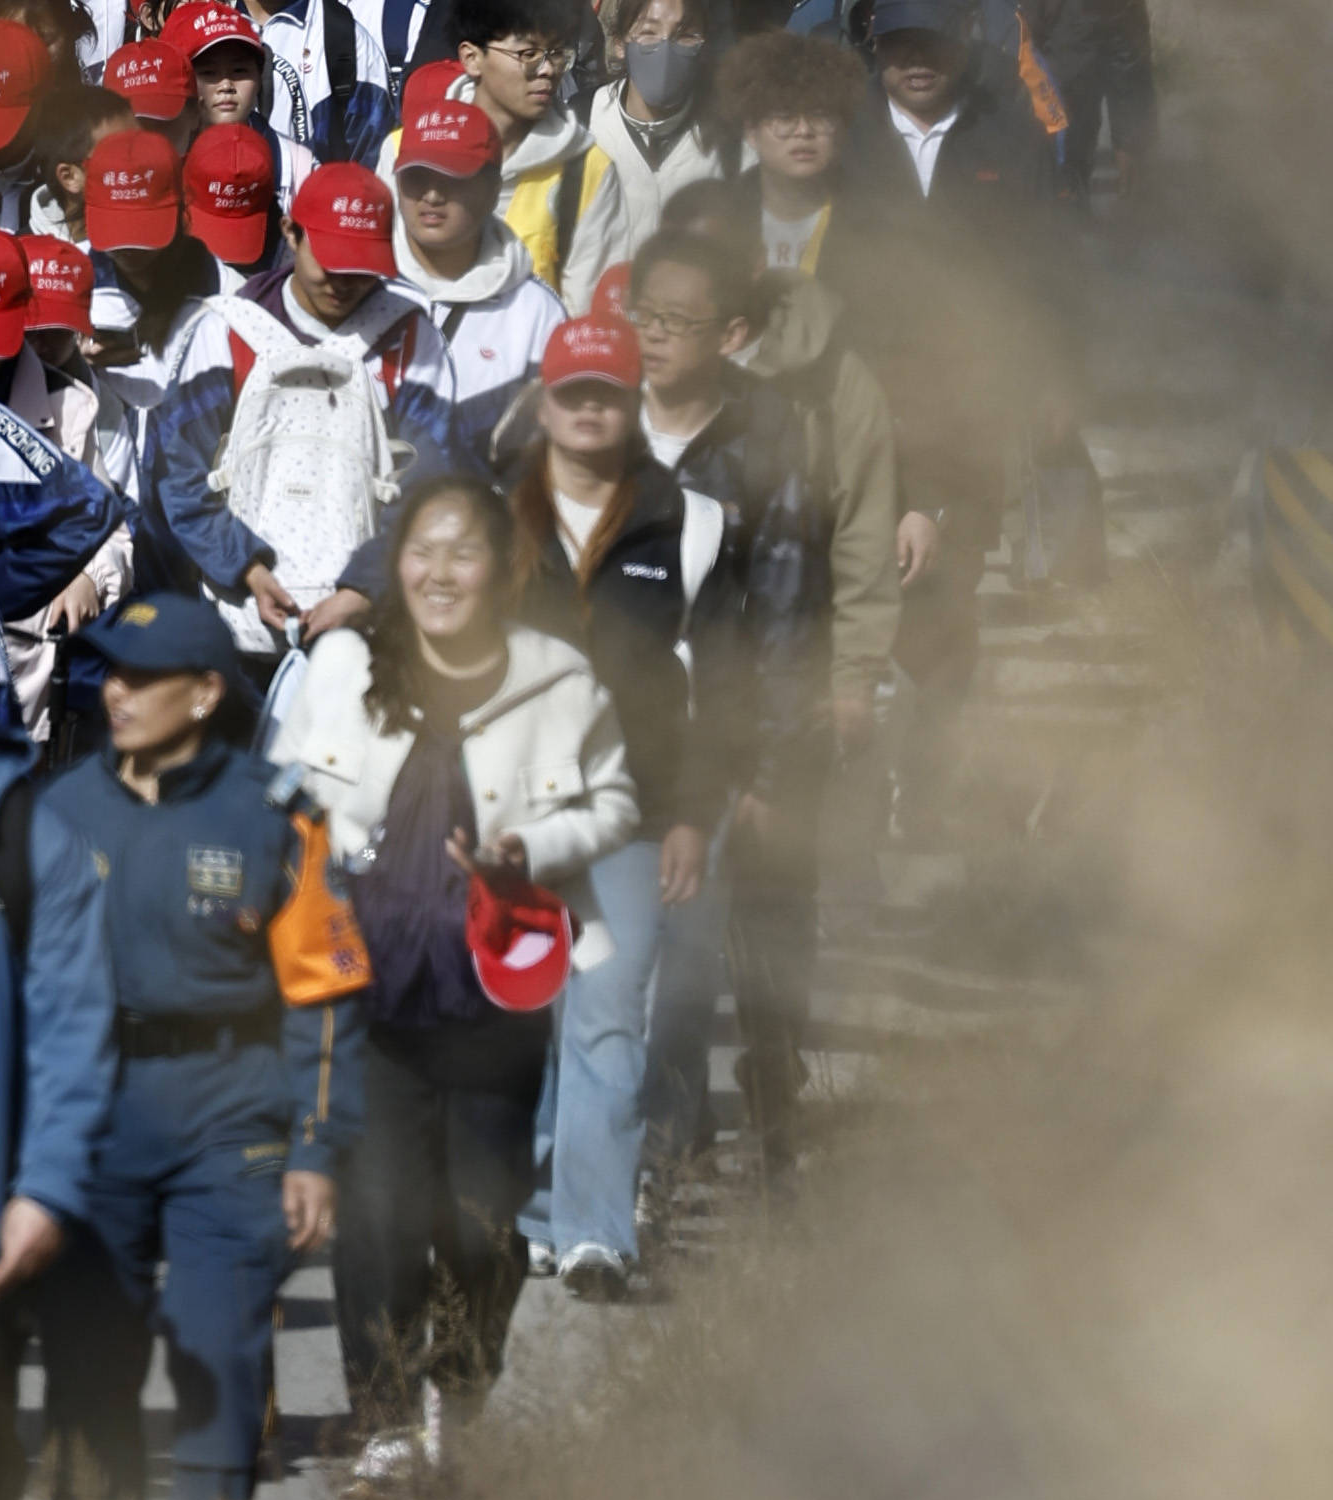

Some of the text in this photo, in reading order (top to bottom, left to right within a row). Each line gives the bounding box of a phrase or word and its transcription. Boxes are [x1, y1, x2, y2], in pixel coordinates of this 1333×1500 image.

[116, 57, 164, 79] 固原二中
[30, 260, 82, 278] 固原二中
